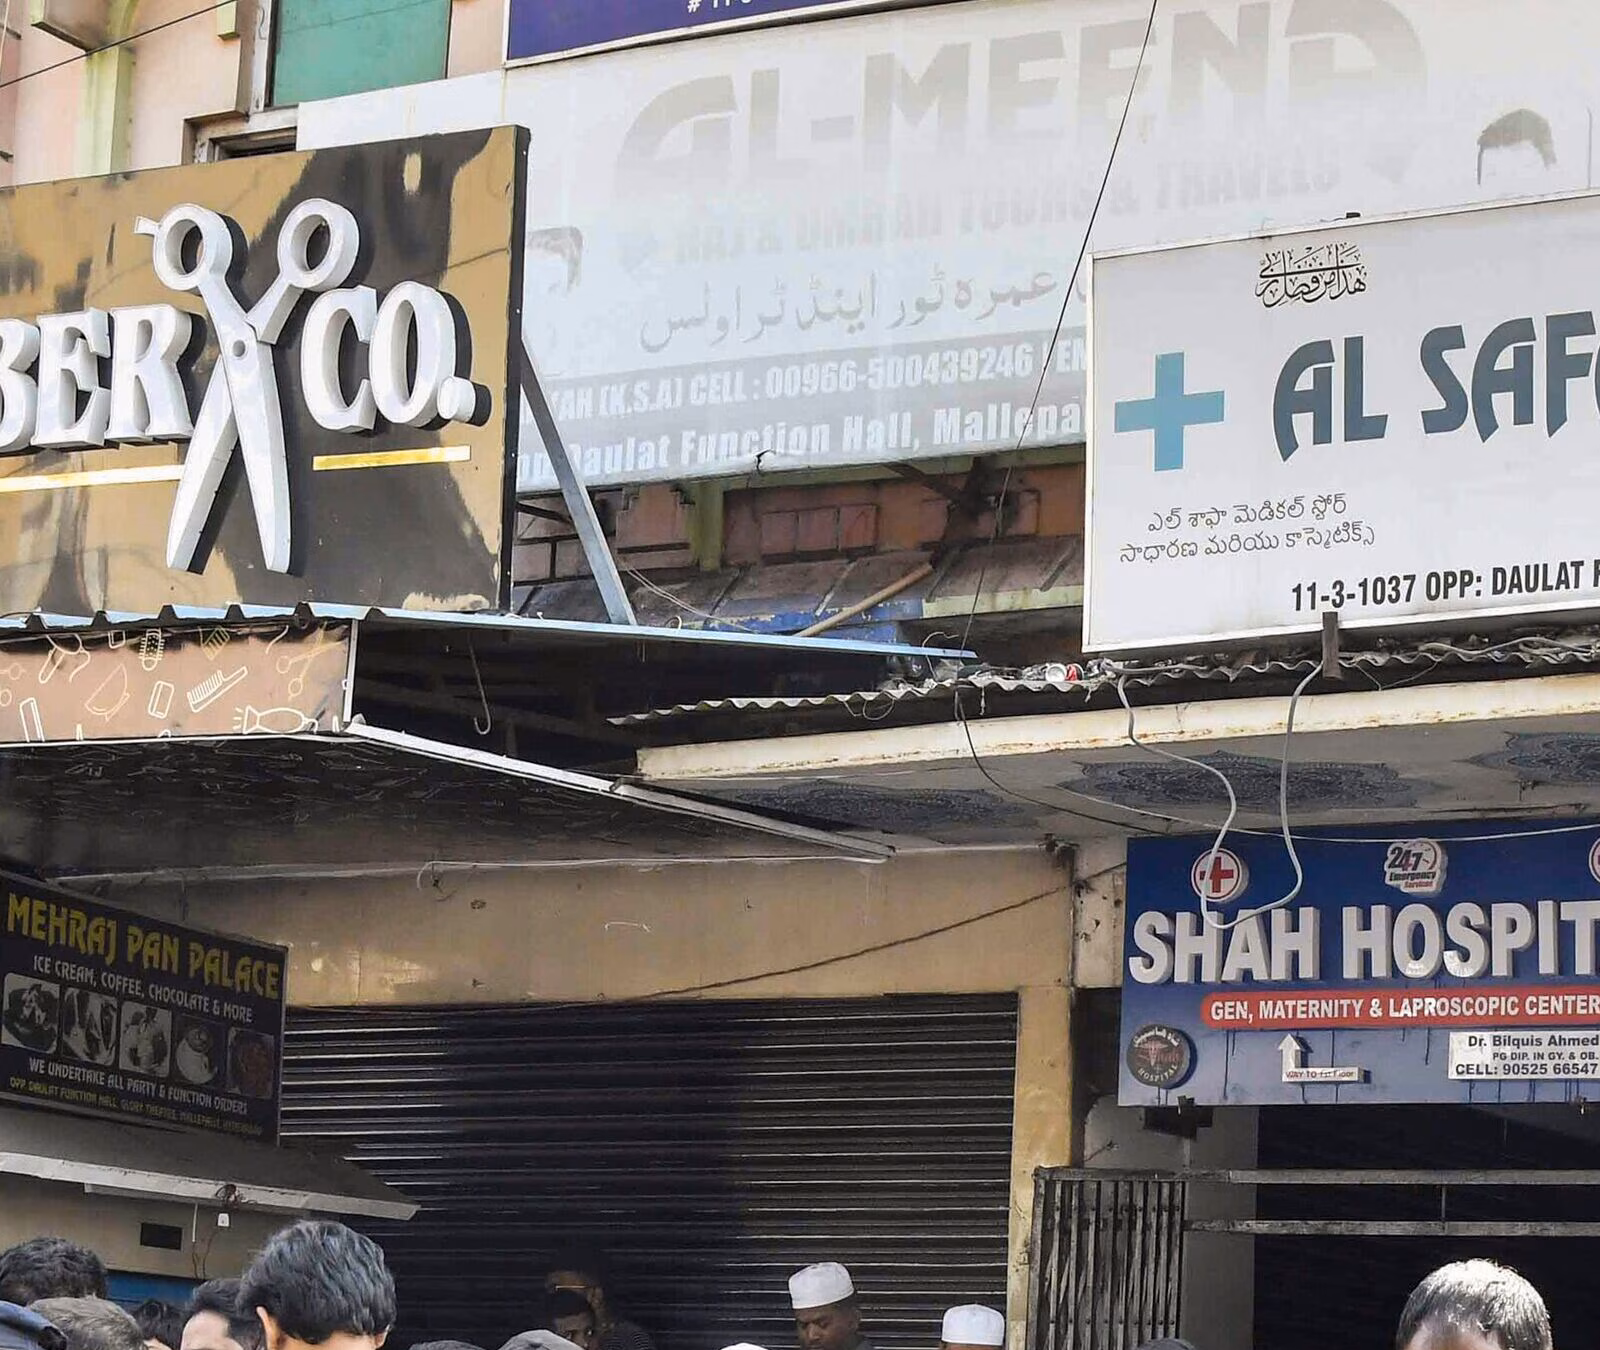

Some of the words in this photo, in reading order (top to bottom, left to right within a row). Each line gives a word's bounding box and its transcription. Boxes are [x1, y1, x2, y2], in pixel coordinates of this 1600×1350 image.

[301, 280, 485, 431] CO.
[1271, 335, 1388, 461] AL
[679, 421, 831, 468] Function
[841, 411, 920, 453] Hall,
[1291, 575, 1417, 613] 11-3-1037
[1425, 568, 1483, 603] OPP:
[1491, 559, 1585, 597] DAULAT
[7, 892, 117, 966] MEHRAJ
[126, 926, 179, 975] PAN
[189, 942, 280, 999] PALACE
[1128, 905, 1321, 984] SHAH
[33, 955, 51, 974] ICE
[54, 961, 97, 987] CREAM,
[100, 972, 145, 999] COFFEE,
[148, 983, 211, 1015] CHOCOLATE
[222, 1002, 253, 1024] MORE
[1210, 997, 1255, 1026] GEN,
[1258, 996, 1364, 1021] MATERNITY
[1369, 998, 1384, 1018] &
[1388, 993, 1521, 1018] LAPROSCOPIC
[1468, 1035, 1488, 1047] Dr.
[1492, 1034, 1543, 1049] Bilquis
[1547, 1034, 1600, 1047] Ahmed
[1492, 1052, 1507, 1061] PG
[1510, 1052, 1530, 1061] DIP.
[1533, 1052, 1545, 1061] IN
[1547, 1052, 1566, 1061] GY.
[1568, 1052, 1576, 1061] &
[1580, 1051, 1600, 1061] OB.
[29, 1057, 46, 1073] WE
[48, 1060, 106, 1087] UNDERTAKE
[107, 1072, 125, 1090] ALL
[126, 1077, 157, 1099] PARTY
[168, 1085, 213, 1108] FUNCTION
[1455, 1064, 1498, 1076] CELL:
[1503, 1063, 1548, 1076] 90525
[1553, 1063, 1599, 1075] 66547
